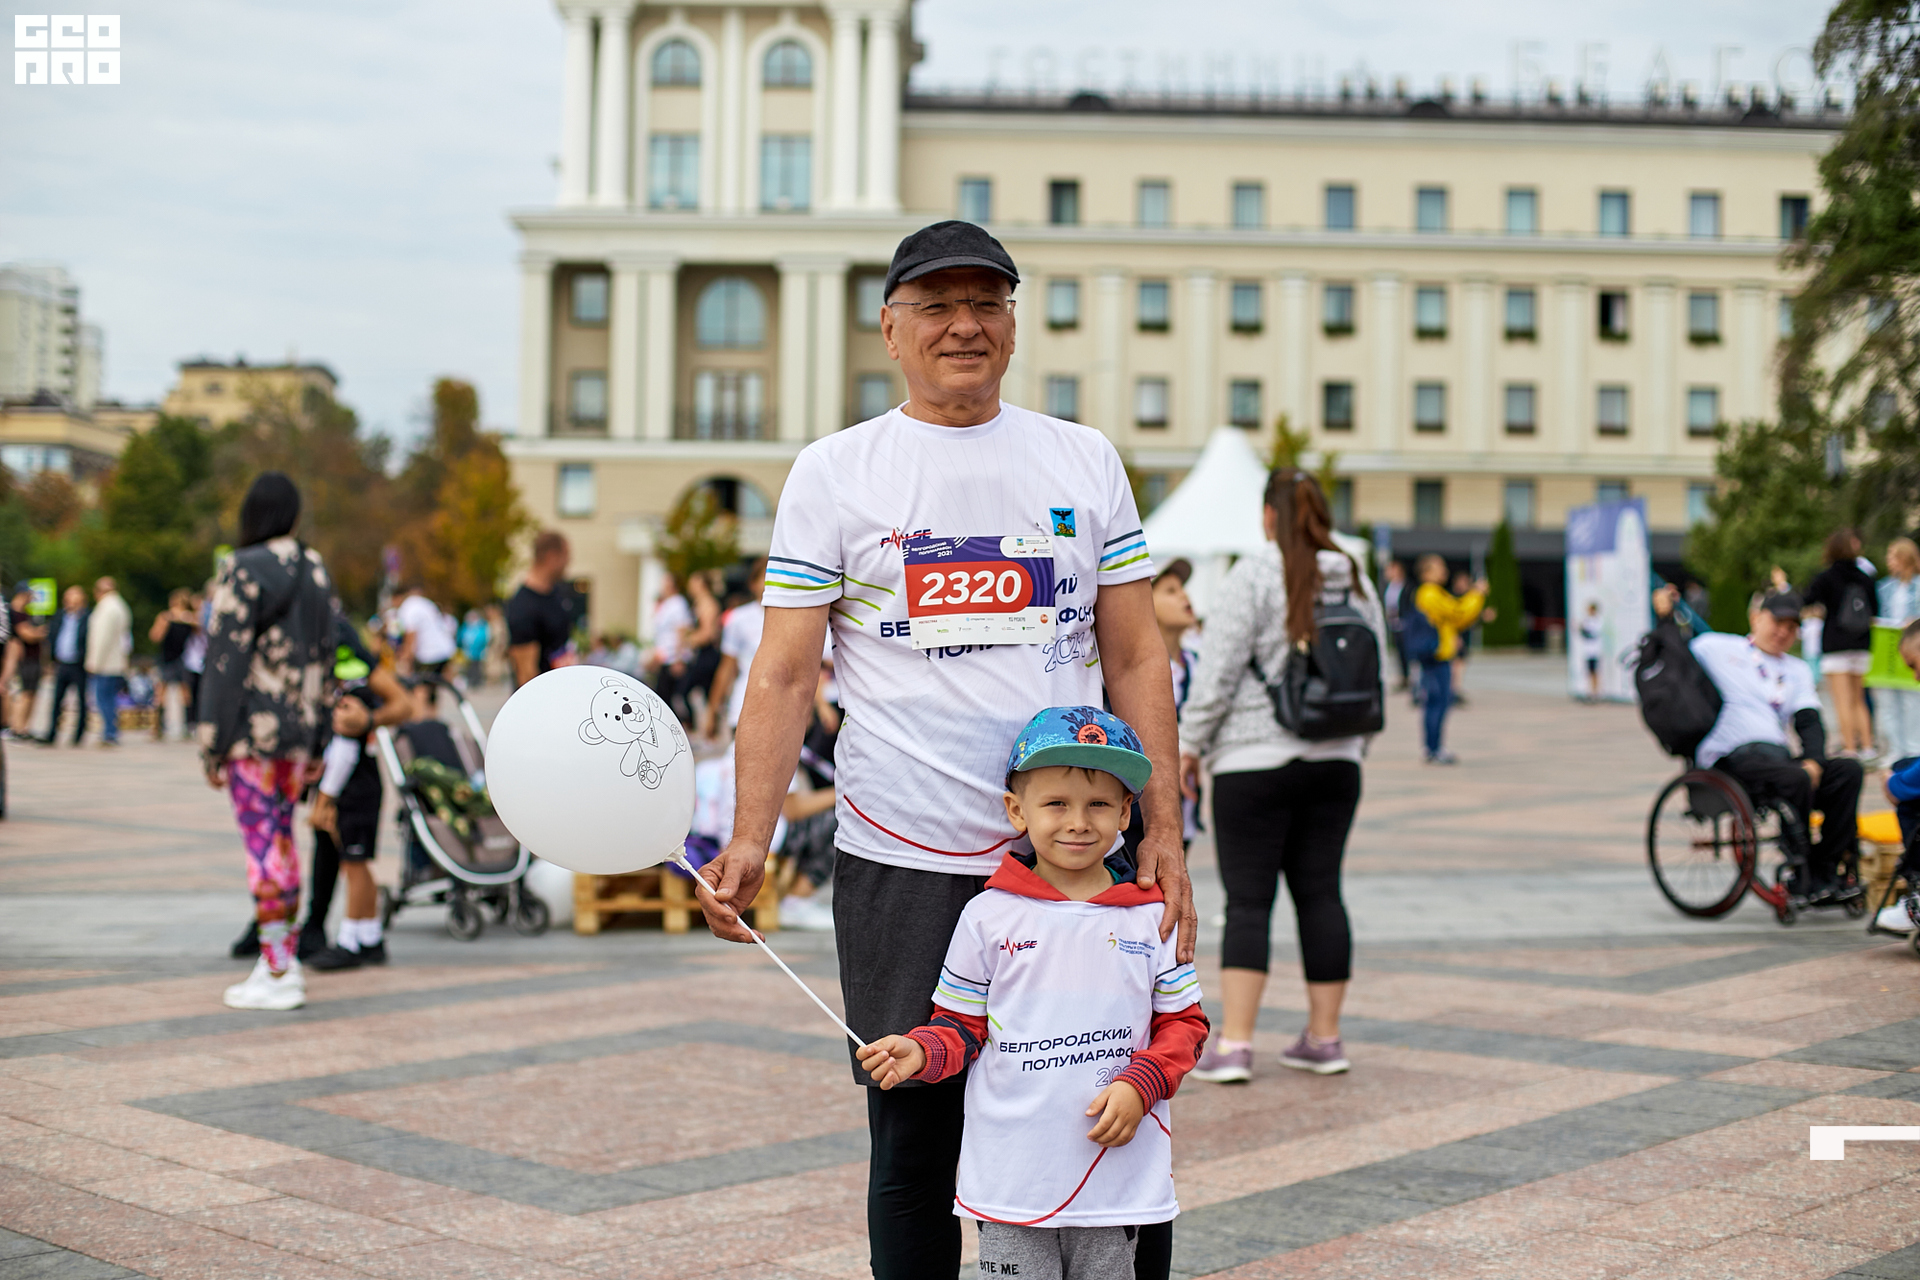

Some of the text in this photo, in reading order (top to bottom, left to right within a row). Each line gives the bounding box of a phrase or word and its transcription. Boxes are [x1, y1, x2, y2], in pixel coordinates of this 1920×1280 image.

[937, 550, 953, 558] 2021
[918, 569, 1022, 607] 2320
[1000, 1026, 1132, 1053] БЕЛГОРОДСКИЙ
[1022, 1047, 1136, 1071] ПОЛУМАРАФО
[1001, 1263, 1019, 1275] ME
